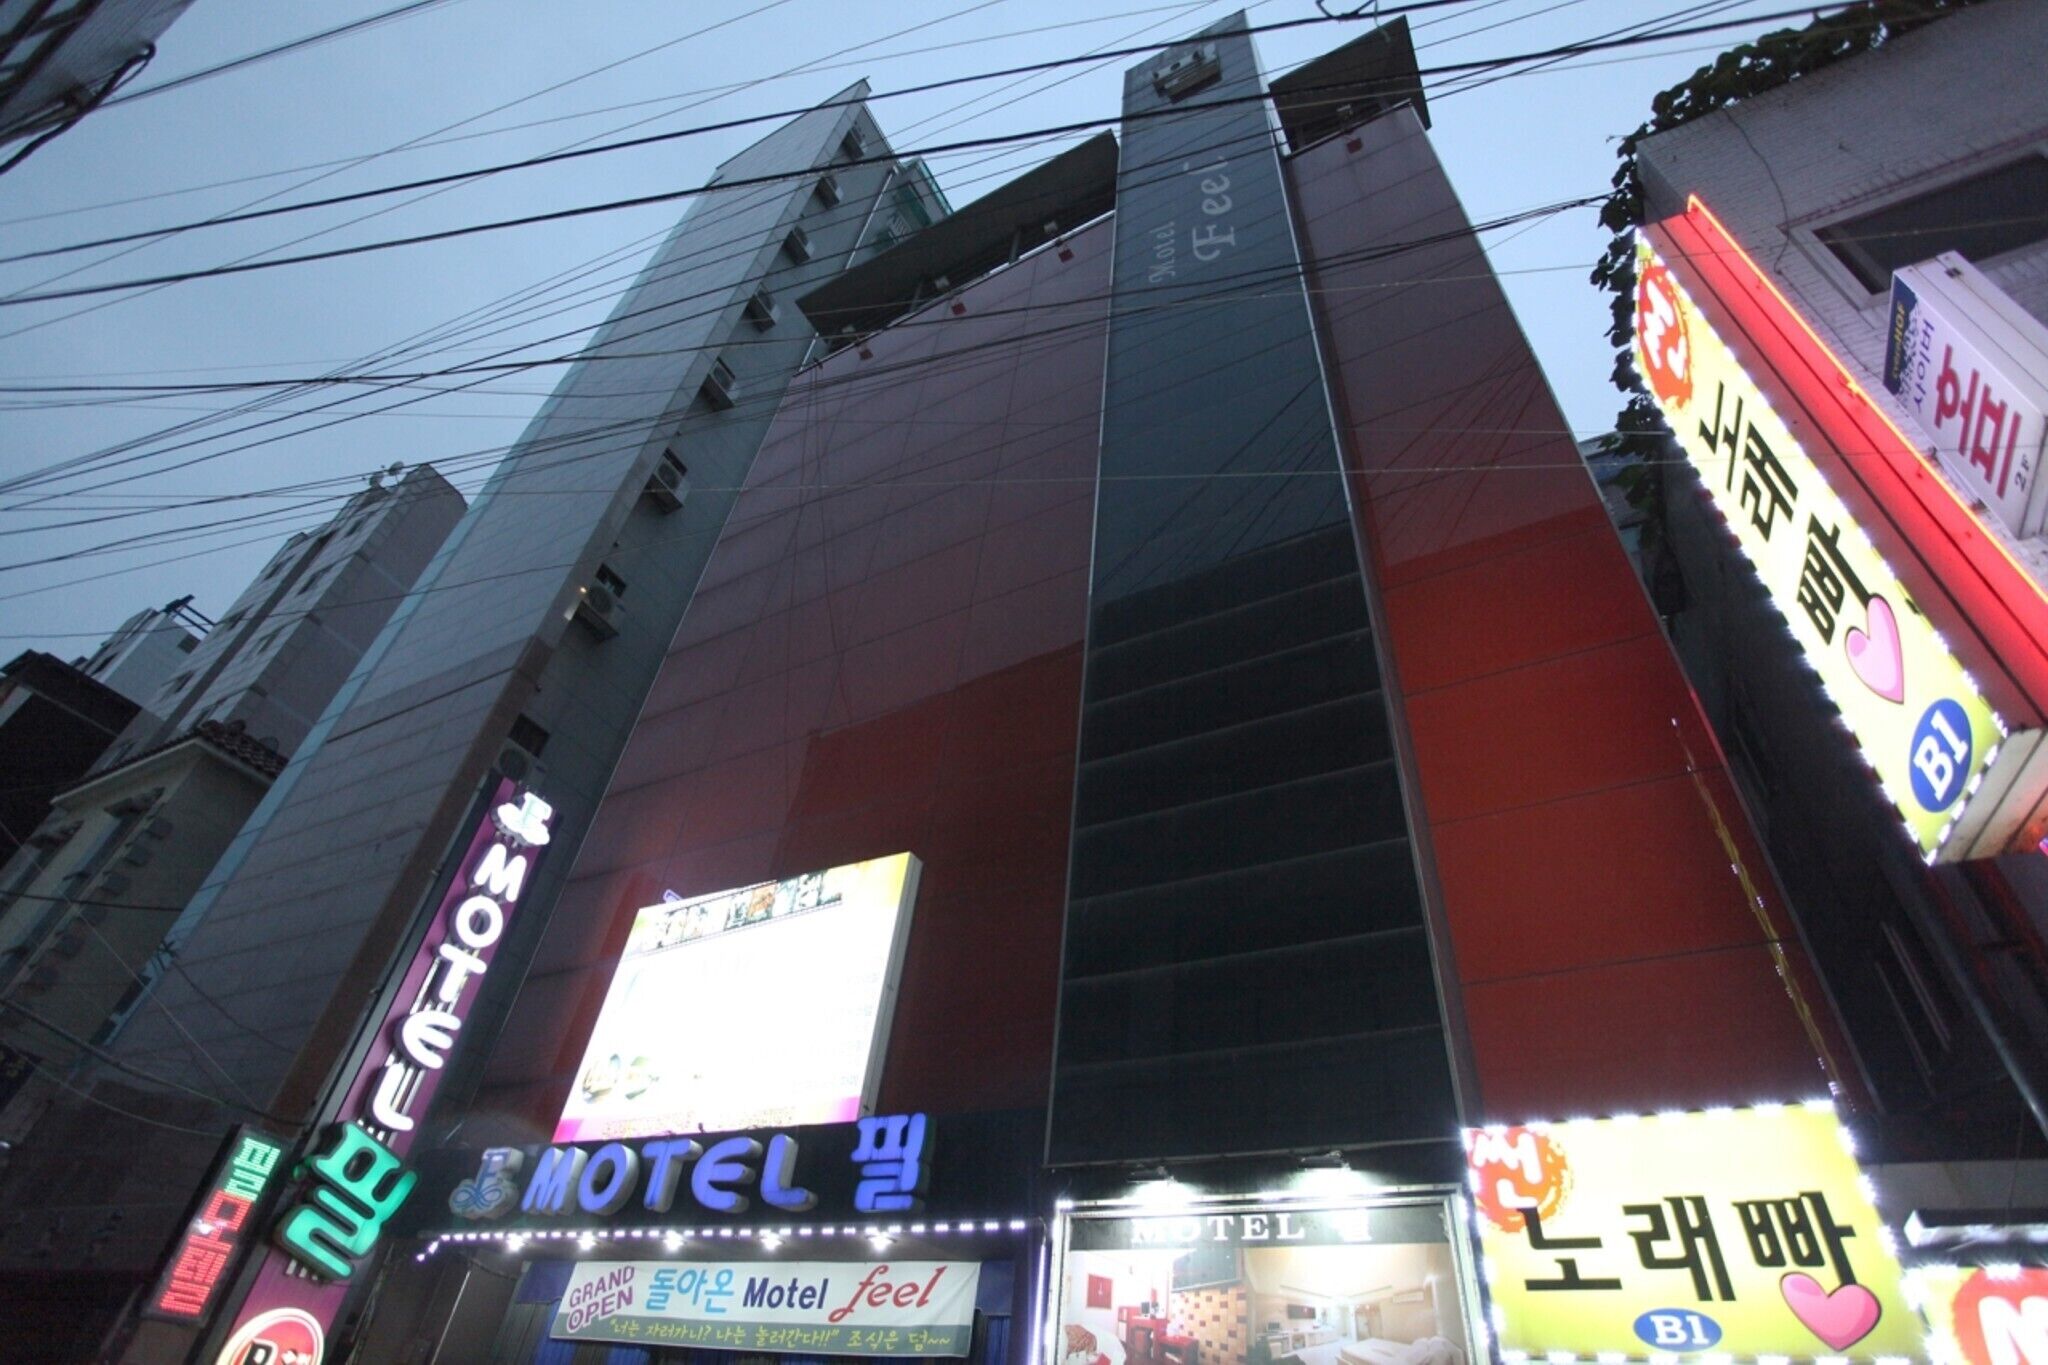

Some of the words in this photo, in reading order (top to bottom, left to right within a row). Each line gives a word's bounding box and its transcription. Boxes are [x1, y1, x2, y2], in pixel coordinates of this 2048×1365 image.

[1933, 342, 2023, 501] 호프
[1913, 709, 1969, 802] B1
[372, 843, 528, 1131] MOTEL
[521, 1133, 817, 1215] MOTEL
[850, 1112, 929, 1214] 필
[283, 1121, 418, 1278] 필
[1130, 1213, 1306, 1243] MOTEL
[567, 1286, 634, 1331] OPEN
[569, 1265, 635, 1308] GRAND
[646, 1268, 735, 1313] 돌아온
[743, 1276, 829, 1310] Motel
[828, 1264, 948, 1323] feel
[716, 1326, 746, 1345] 나는
[847, 1330, 899, 1352] 조식은
[1649, 1314, 1710, 1346] B1
